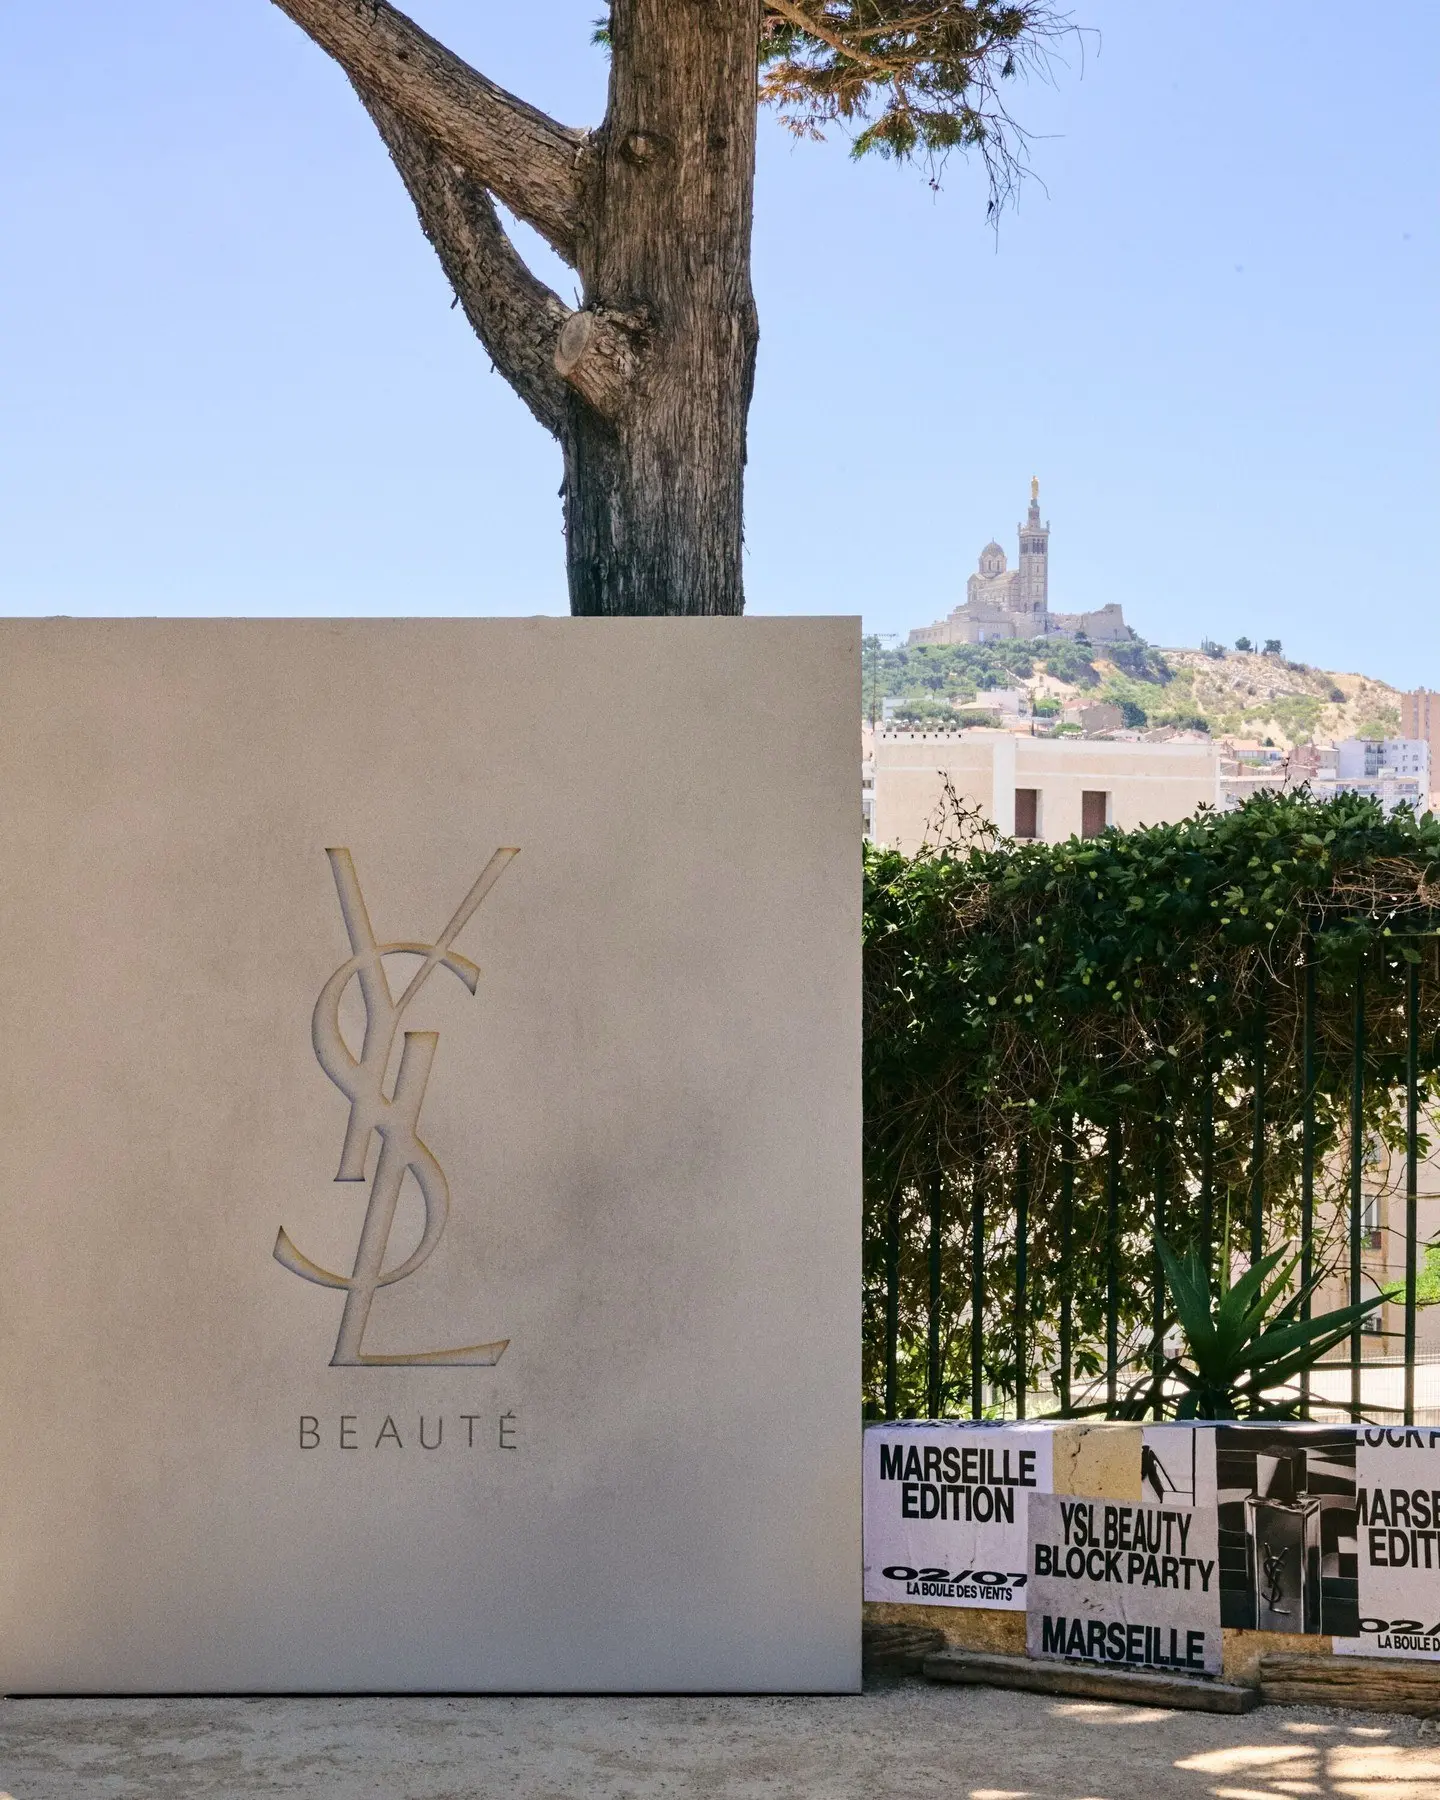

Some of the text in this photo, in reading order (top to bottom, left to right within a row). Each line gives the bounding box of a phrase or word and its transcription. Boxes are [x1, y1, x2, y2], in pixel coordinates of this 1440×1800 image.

[299, 1410, 518, 1450] BEAUTÉ
[880, 1444, 1037, 1487] MARSEILLE
[901, 1482, 1014, 1523] EDITION
[1060, 1502, 1192, 1557] YSL BEAUTY
[882, 1566, 1027, 1587] 02/07
[1035, 1544, 1215, 1592] BLOCK PARTY
[906, 1581, 1013, 1601] LA BOULE DES VENTS
[1042, 1615, 1205, 1669] MARSEILLE
[1377, 1634, 1393, 1649] LA
[1394, 1636, 1431, 1651] BOULE
